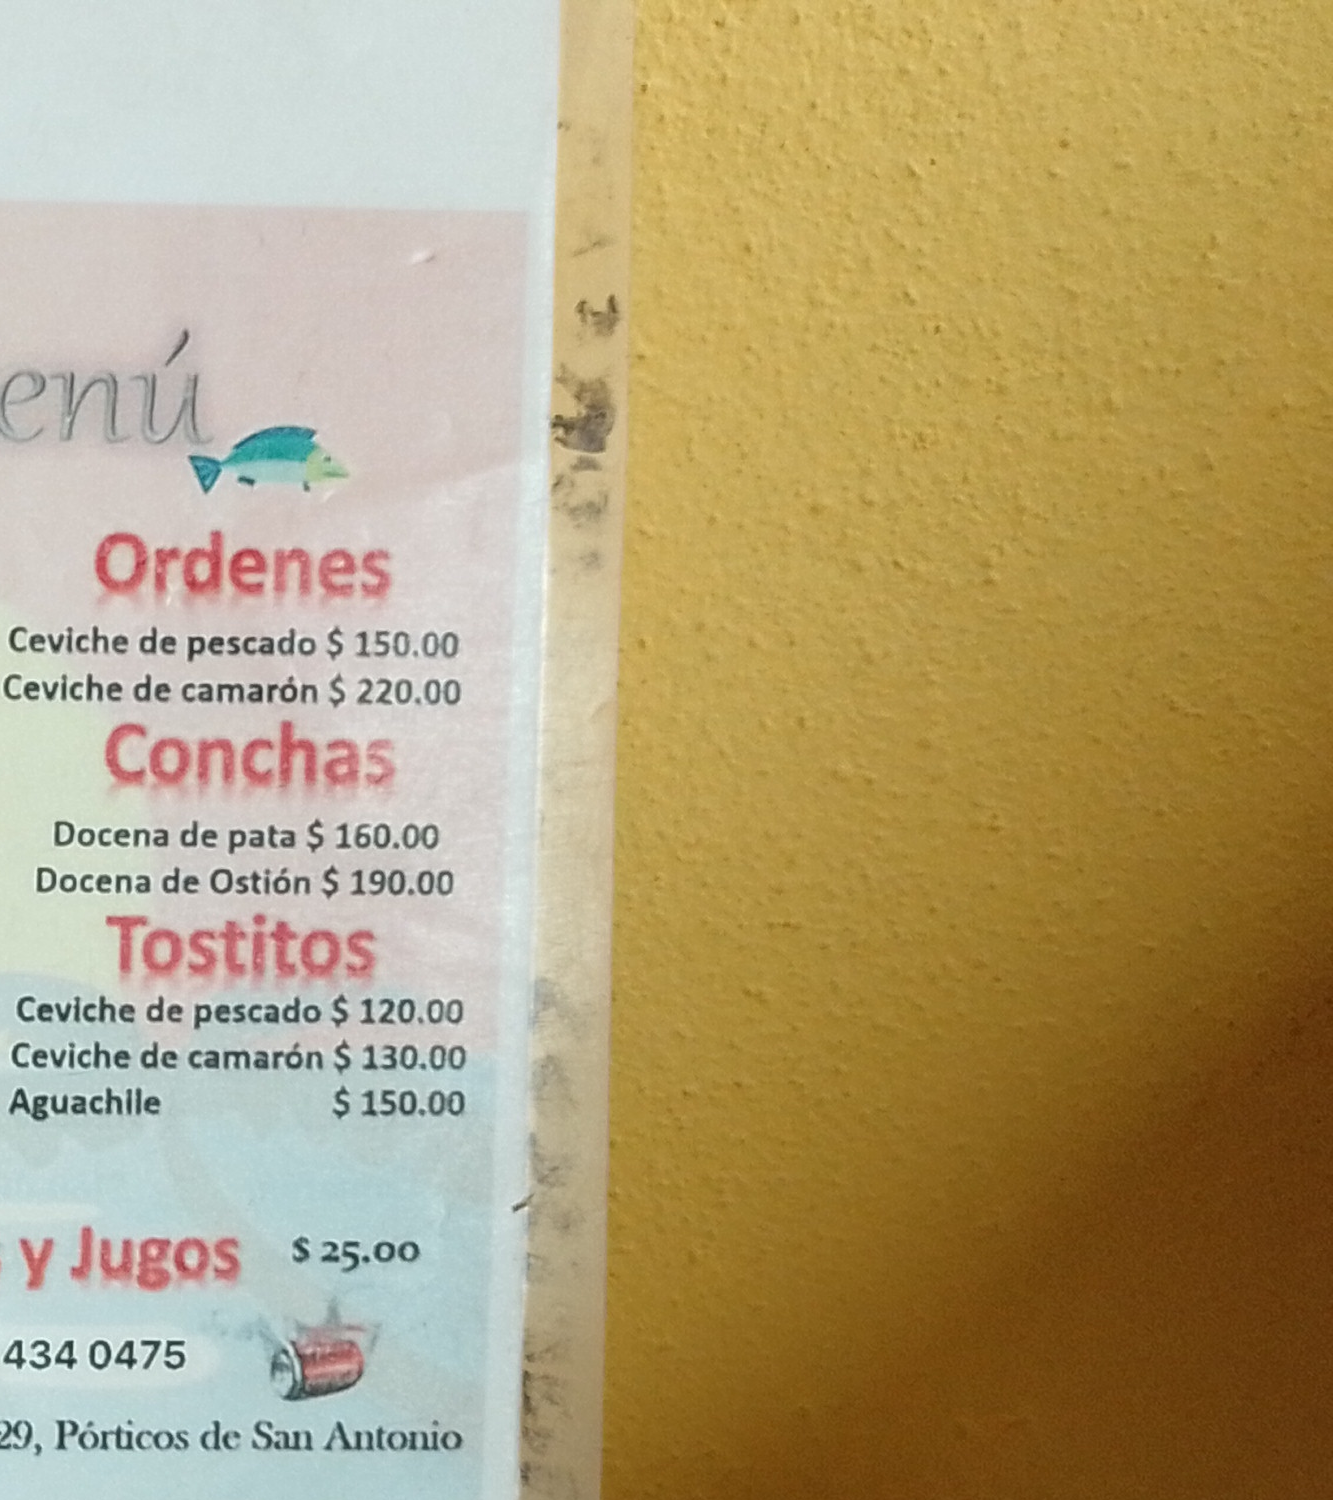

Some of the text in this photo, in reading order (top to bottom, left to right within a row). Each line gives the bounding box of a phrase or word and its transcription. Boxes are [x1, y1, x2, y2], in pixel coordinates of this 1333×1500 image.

[94, 530, 393, 597] Ordenes
[8, 627, 460, 661] Ceviche de pescado $ 150.00
[3, 674, 461, 709] Ceviche de camarón $ 220.00
[105, 721, 396, 786] Conchas
[54, 820, 440, 854] Docena de pata $ 160.00
[35, 865, 455, 900] Docena de Ostión $ 190.00
[106, 914, 378, 978] Tostitos
[16, 995, 464, 1030] Ceviche de pescado $ 120.00
[11, 1041, 467, 1075] Ceviche de camarón $ 130.00
[8, 1086, 465, 1121] Aguachile $ 150.00
[21, 1235, 55, 1290] y
[71, 1226, 242, 1291] Jugos
[292, 1236, 420, 1272] $ 25.00
[3, 1339, 78, 1370] 434
[88, 1339, 187, 1371] 0475
[55, 1418, 190, 1452] Pórticos
[200, 1419, 241, 1452] de
[252, 1420, 314, 1452] San
[324, 1419, 464, 1452] Antonio
